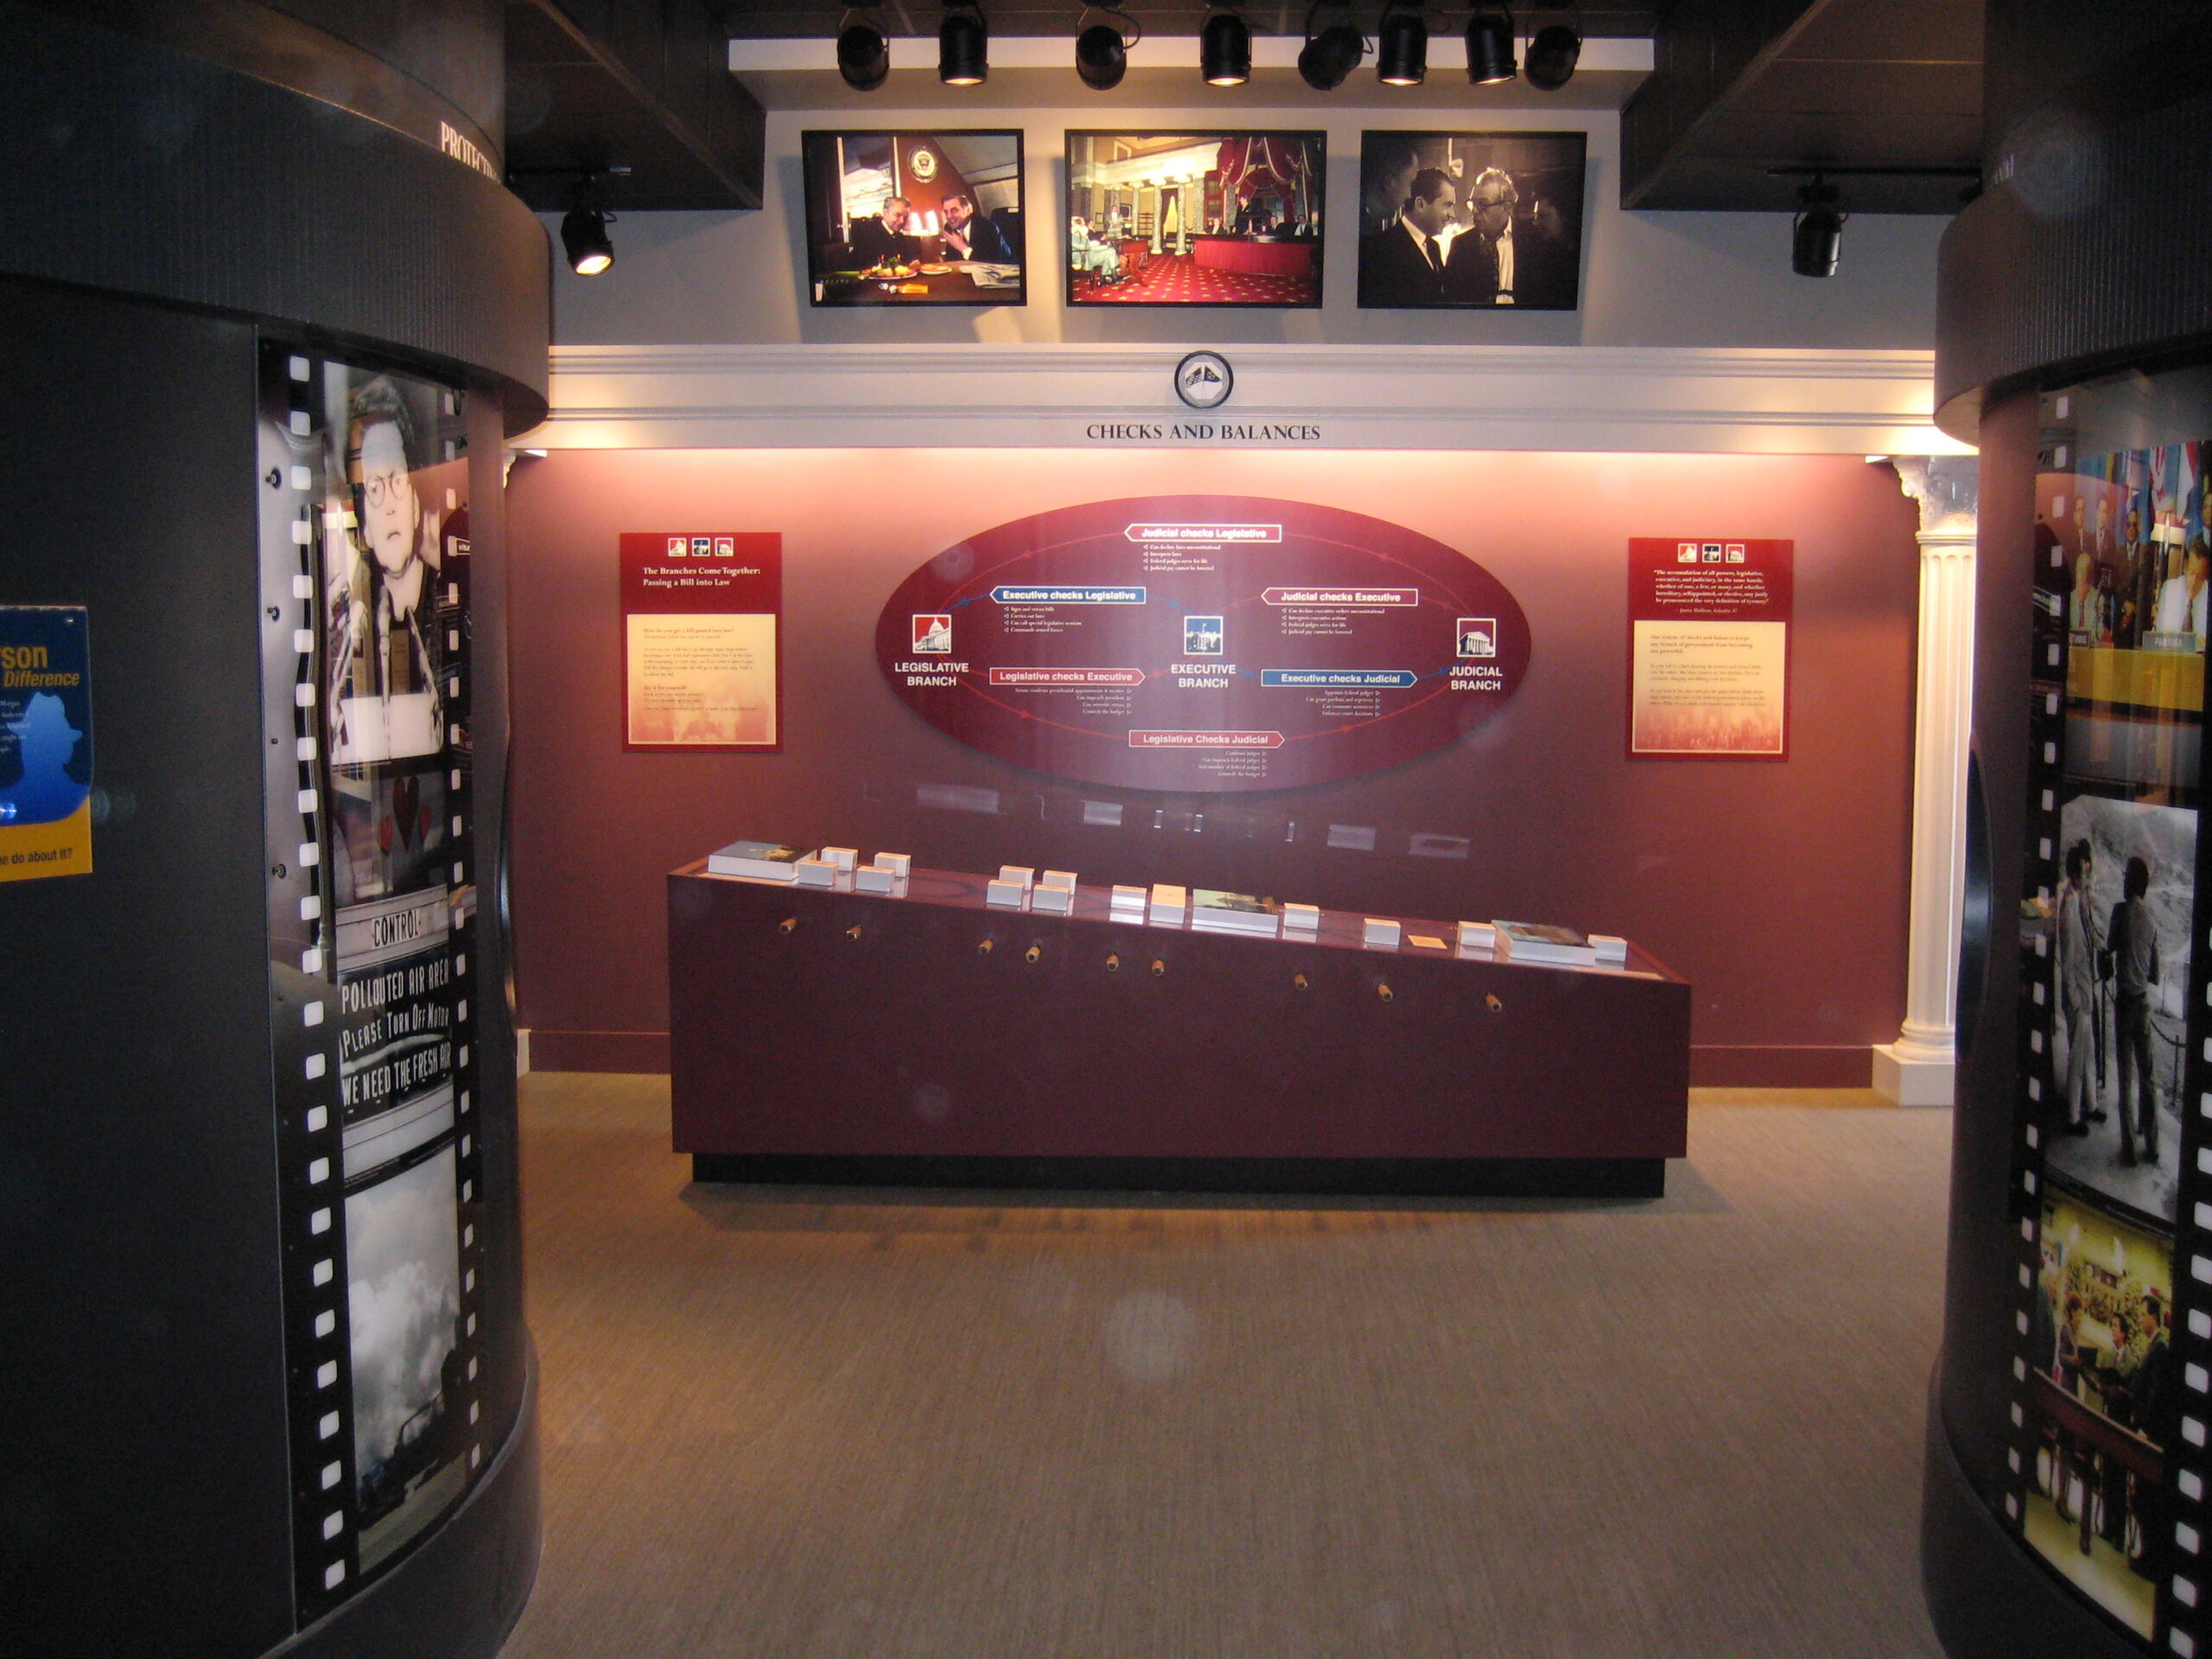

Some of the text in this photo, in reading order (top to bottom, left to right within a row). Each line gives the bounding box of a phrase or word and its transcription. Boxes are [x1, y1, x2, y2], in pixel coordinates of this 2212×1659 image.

[1086, 424, 1321, 440] CHECKS AND BALANCES
[1141, 528, 1267, 540] Judicial checks Legislative
[721, 567, 760, 577] Together:
[643, 578, 672, 588] Passing
[1002, 590, 1136, 602] Executive checks Legislative
[1281, 592, 1401, 602] Judicial checks Executive
[0, 646, 48, 669] son
[1171, 664, 1236, 674] EXECUTIVE
[1449, 666, 1503, 677] JUDICIAL
[3, 671, 80, 687] Difference
[907, 677, 957, 686] BRANCH
[1000, 671, 1133, 683] Legislative checks Executive
[1179, 677, 1229, 688] BRANCH
[1281, 674, 1401, 683] Executive checks Judicial
[1451, 680, 1501, 690] BRANCH
[1143, 734, 1268, 745] Legislative Checks Judicial
[11, 853, 24, 864] do
[28, 849, 57, 862] about
[60, 847, 73, 859] it?
[373, 909, 419, 948] CONTROL
[341, 957, 449, 1015] POLLOUTED AIR AREA
[342, 1041, 452, 1107] WE NEED THE FRESH AIR
